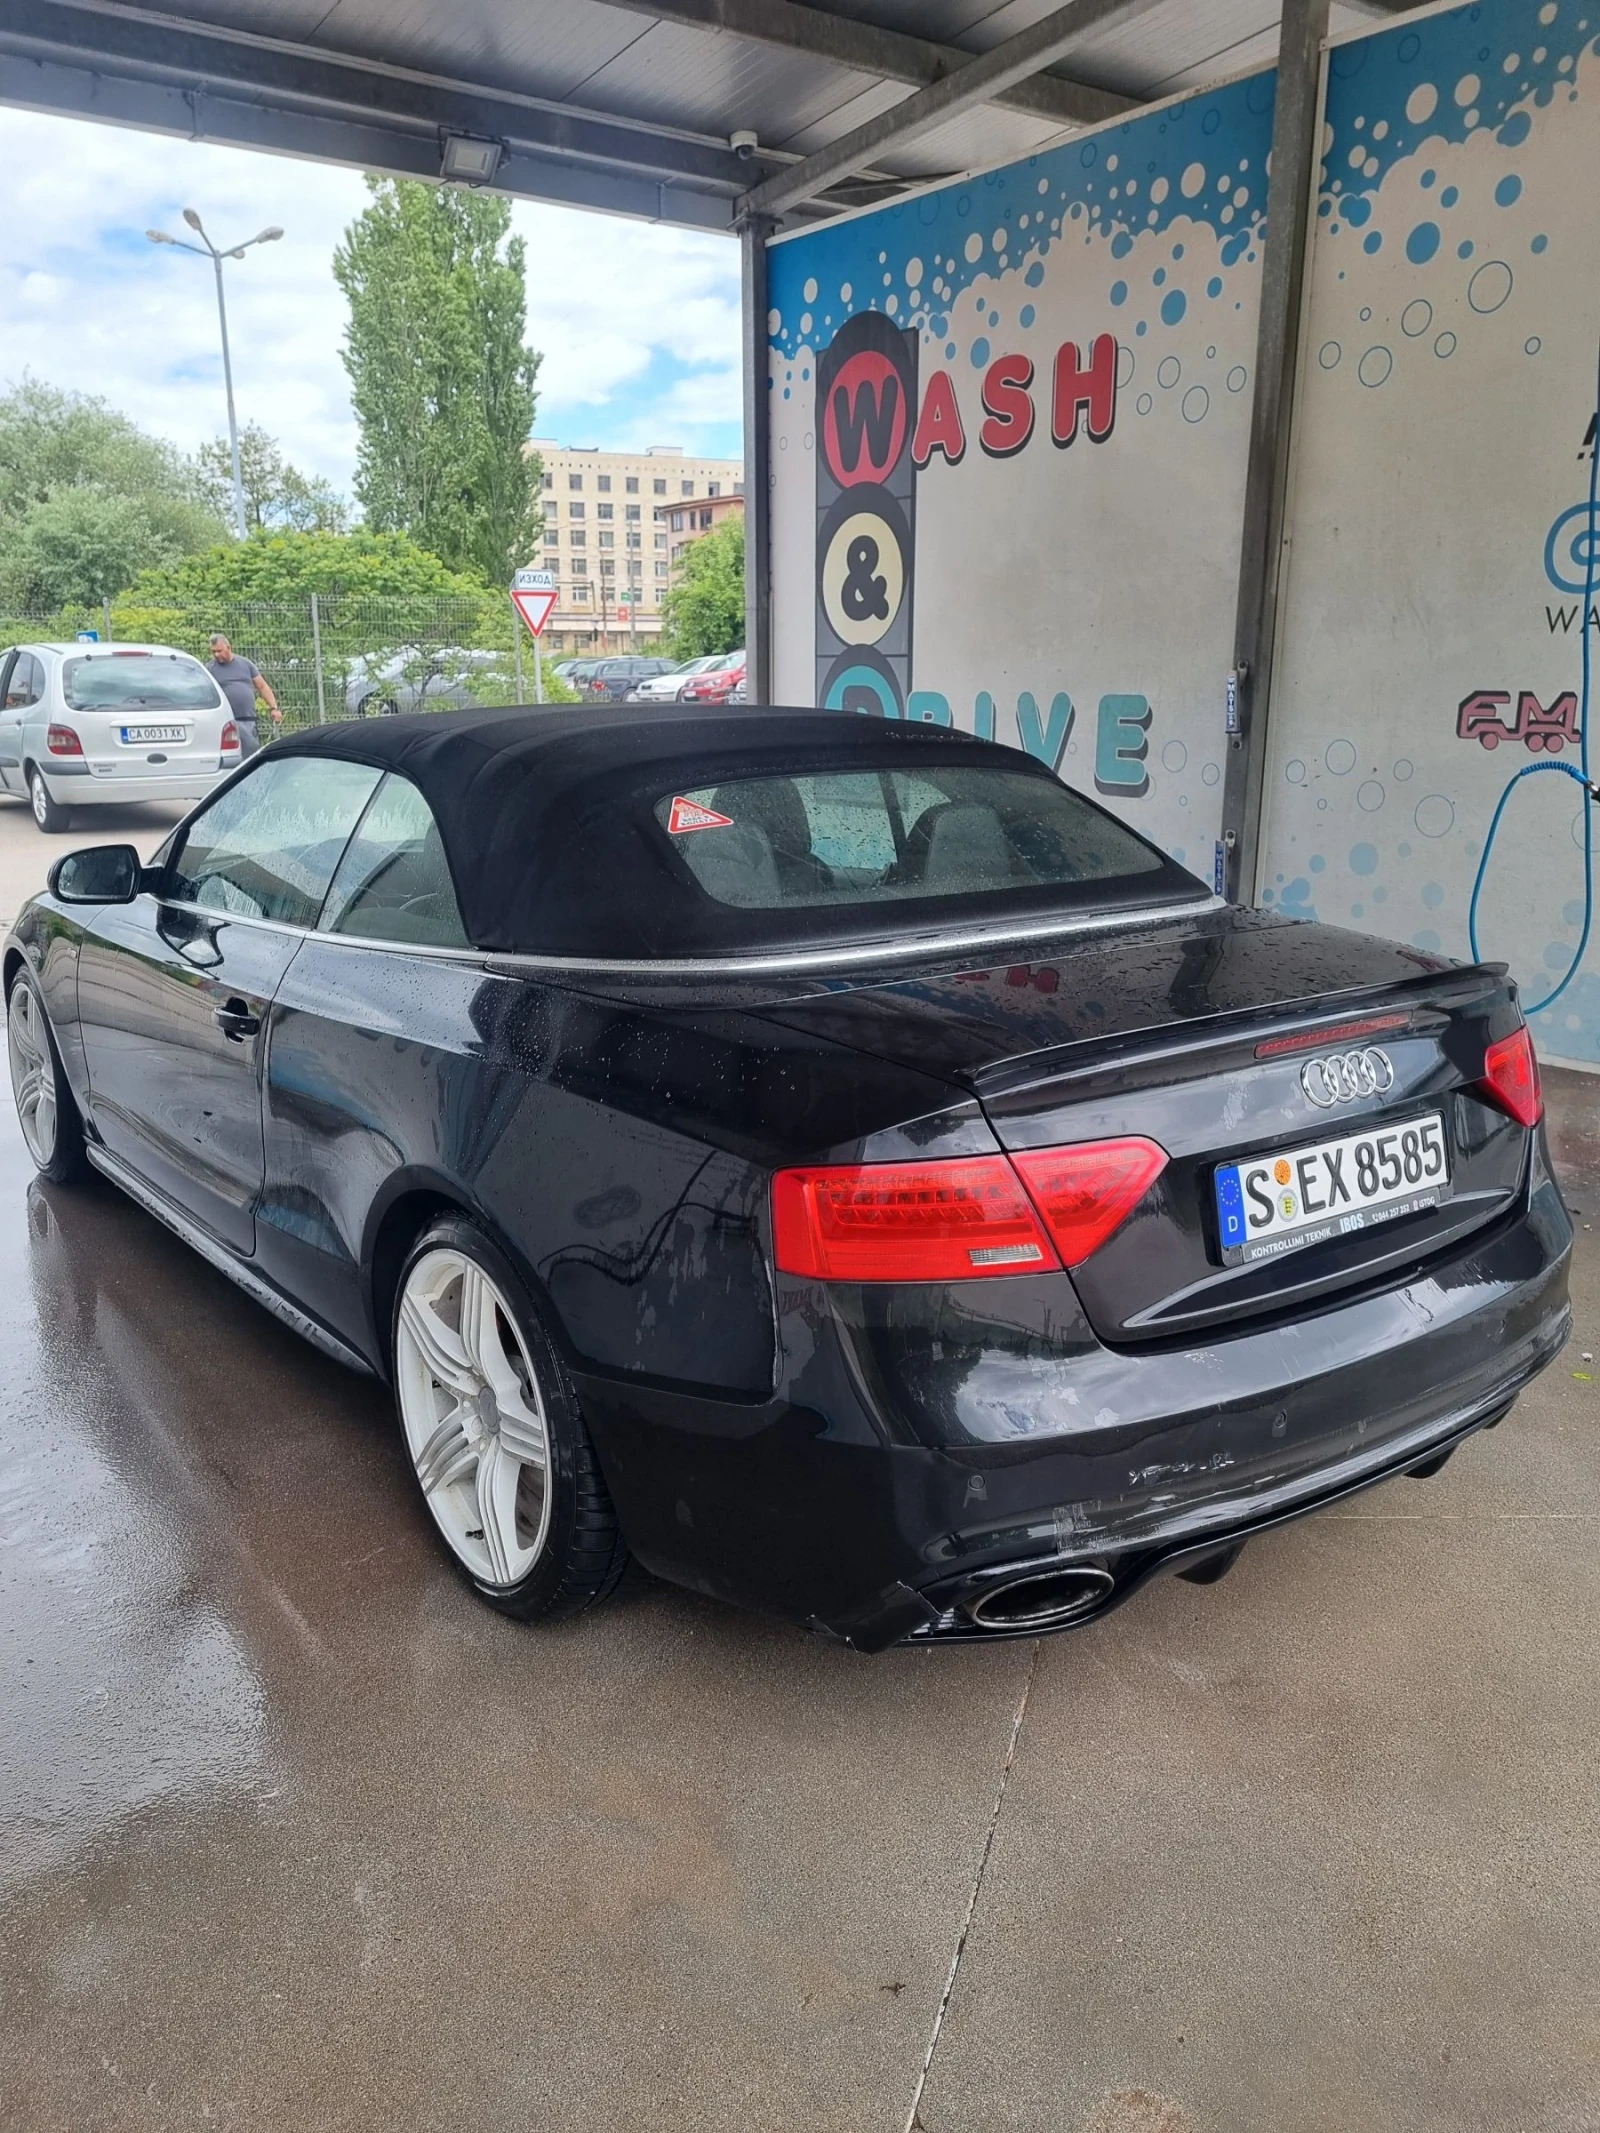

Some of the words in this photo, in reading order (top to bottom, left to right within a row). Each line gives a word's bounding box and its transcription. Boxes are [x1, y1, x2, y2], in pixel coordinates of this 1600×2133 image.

[833, 333, 1118, 474] WASH
[519, 574, 551, 585] ИЗХОД
[841, 534, 890, 621] &
[143, 728, 168, 739] 0031
[1246, 1169, 1275, 1228] S
[1296, 1148, 1352, 1215] EX
[1354, 1122, 1443, 1197] 8585
[1227, 1215, 1239, 1233] D
[1250, 1235, 1304, 1259] KONTROLLIMI
[1305, 1227, 1332, 1244] TEKNIK
[1339, 1213, 1365, 1233] IBOS
